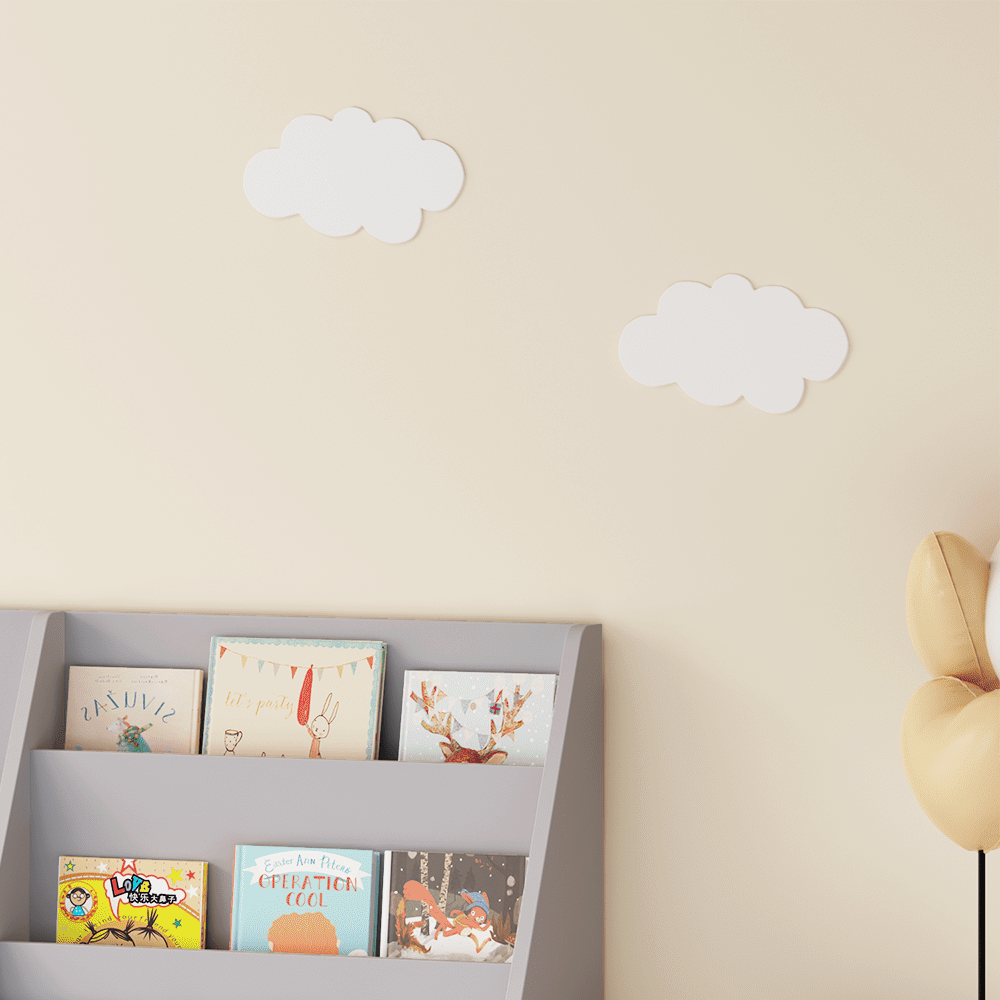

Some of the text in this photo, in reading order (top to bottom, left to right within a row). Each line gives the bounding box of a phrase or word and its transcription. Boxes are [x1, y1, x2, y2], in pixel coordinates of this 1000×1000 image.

[225, 691, 294, 719] let's party
[258, 874, 357, 892] OPERATION
[286, 892, 328, 907] COOL
